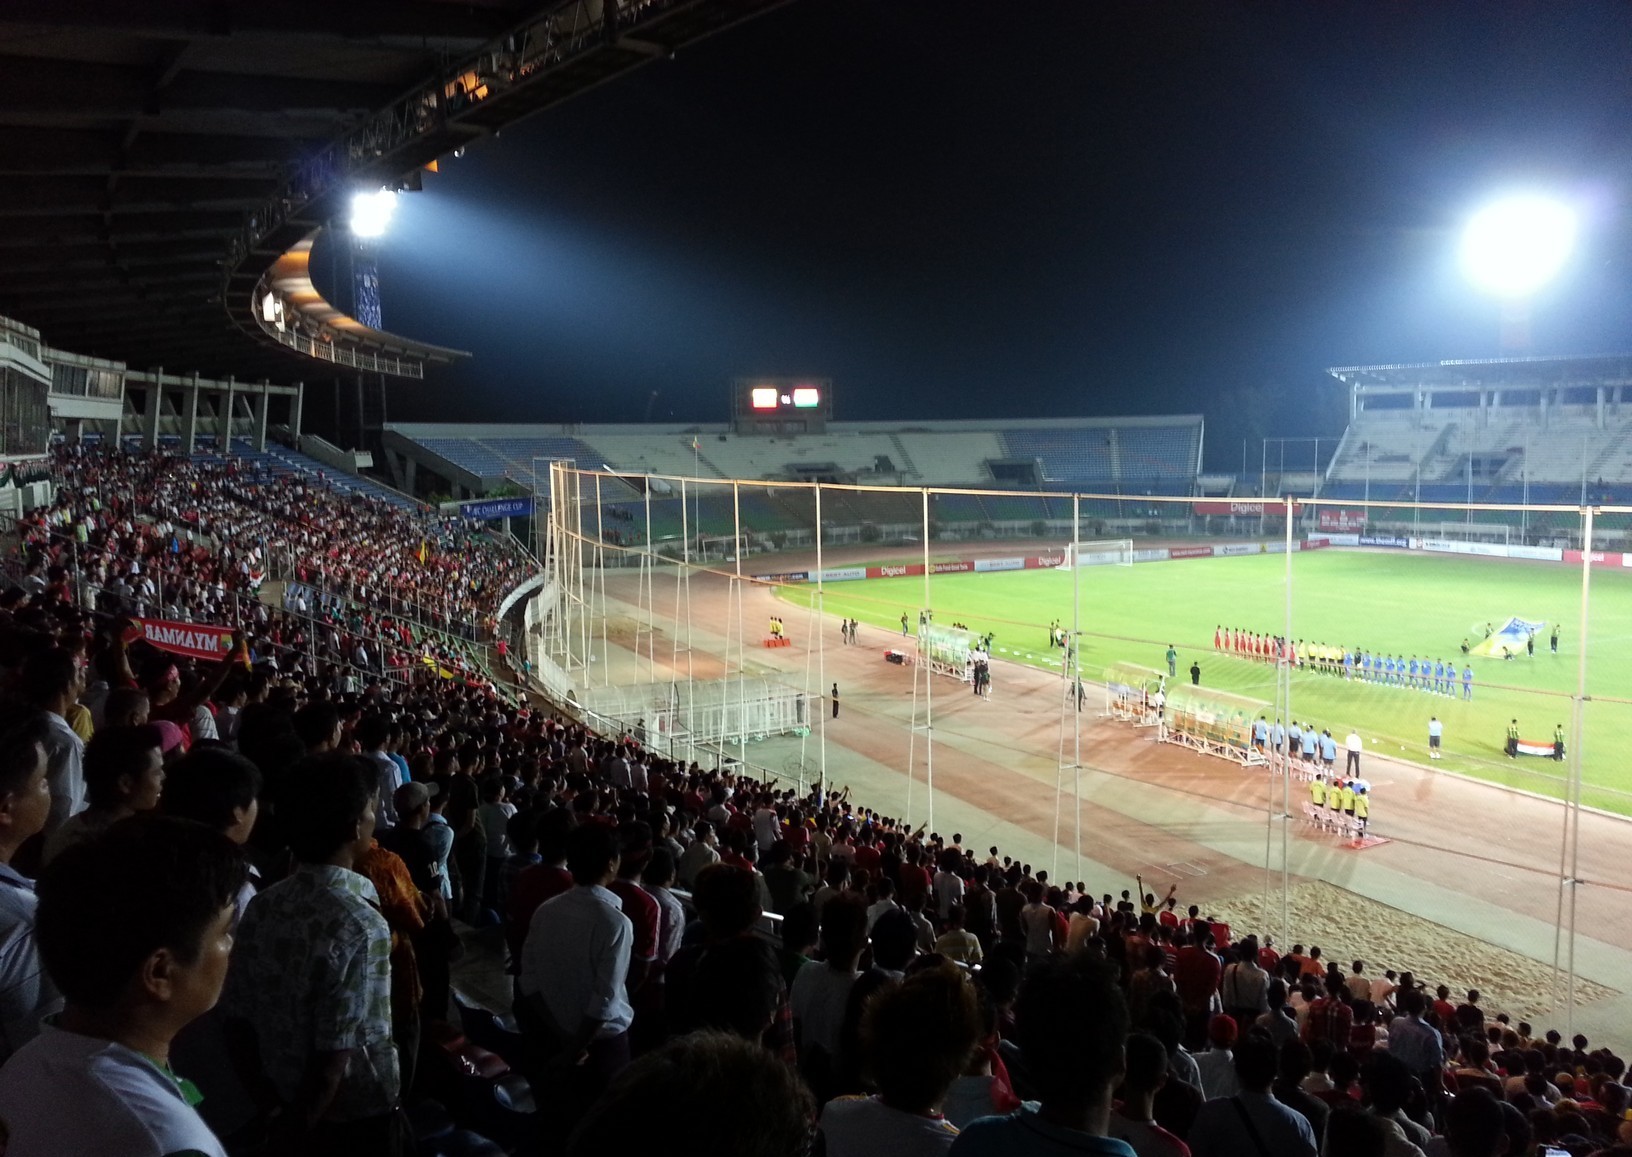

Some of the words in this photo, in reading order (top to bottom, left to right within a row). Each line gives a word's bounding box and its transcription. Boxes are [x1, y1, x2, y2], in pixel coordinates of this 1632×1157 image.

[482, 503, 512, 514] CHALLENGE
[513, 502, 523, 511] CUP
[1038, 556, 1061, 567] Digicel
[881, 565, 906, 577] Digicel
[428, 861, 440, 878] 10
